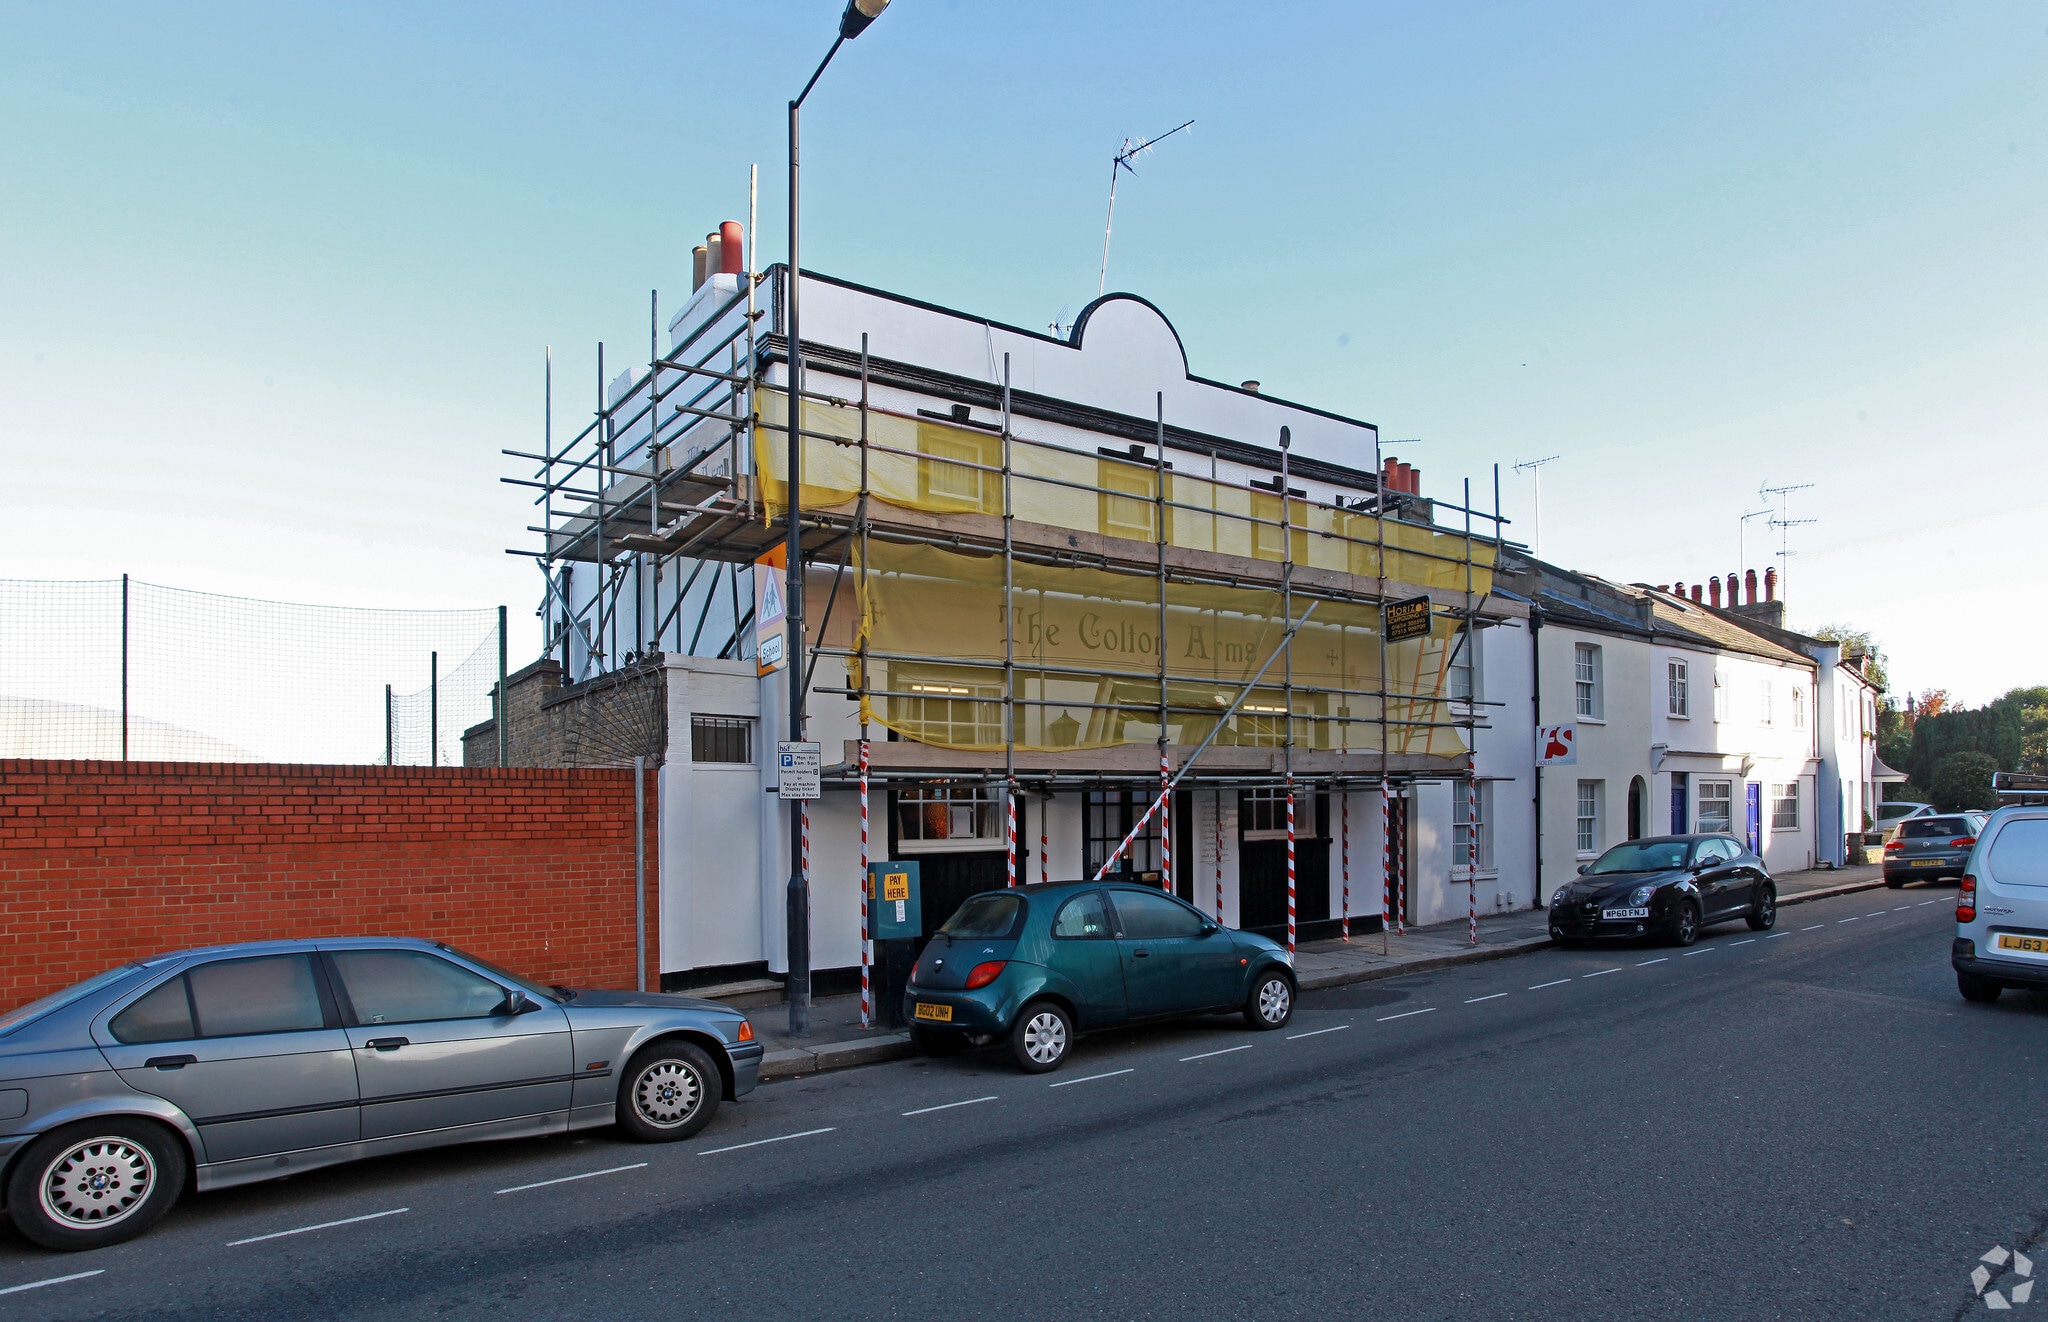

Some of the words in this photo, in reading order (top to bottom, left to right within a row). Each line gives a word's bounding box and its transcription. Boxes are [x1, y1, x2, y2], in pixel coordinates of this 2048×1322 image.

[1387, 600, 1429, 617] HORIZON
[998, 604, 1060, 658] The
[763, 641, 780, 660] School
[889, 875, 901, 885] PAY
[887, 888, 905, 898] HERE
[1606, 909, 1627, 918] WP60
[1629, 908, 1645, 917] FNJ
[2004, 937, 2041, 951] LJ63
[918, 1004, 935, 1017] BG02
[935, 1006, 949, 1018] UNH
